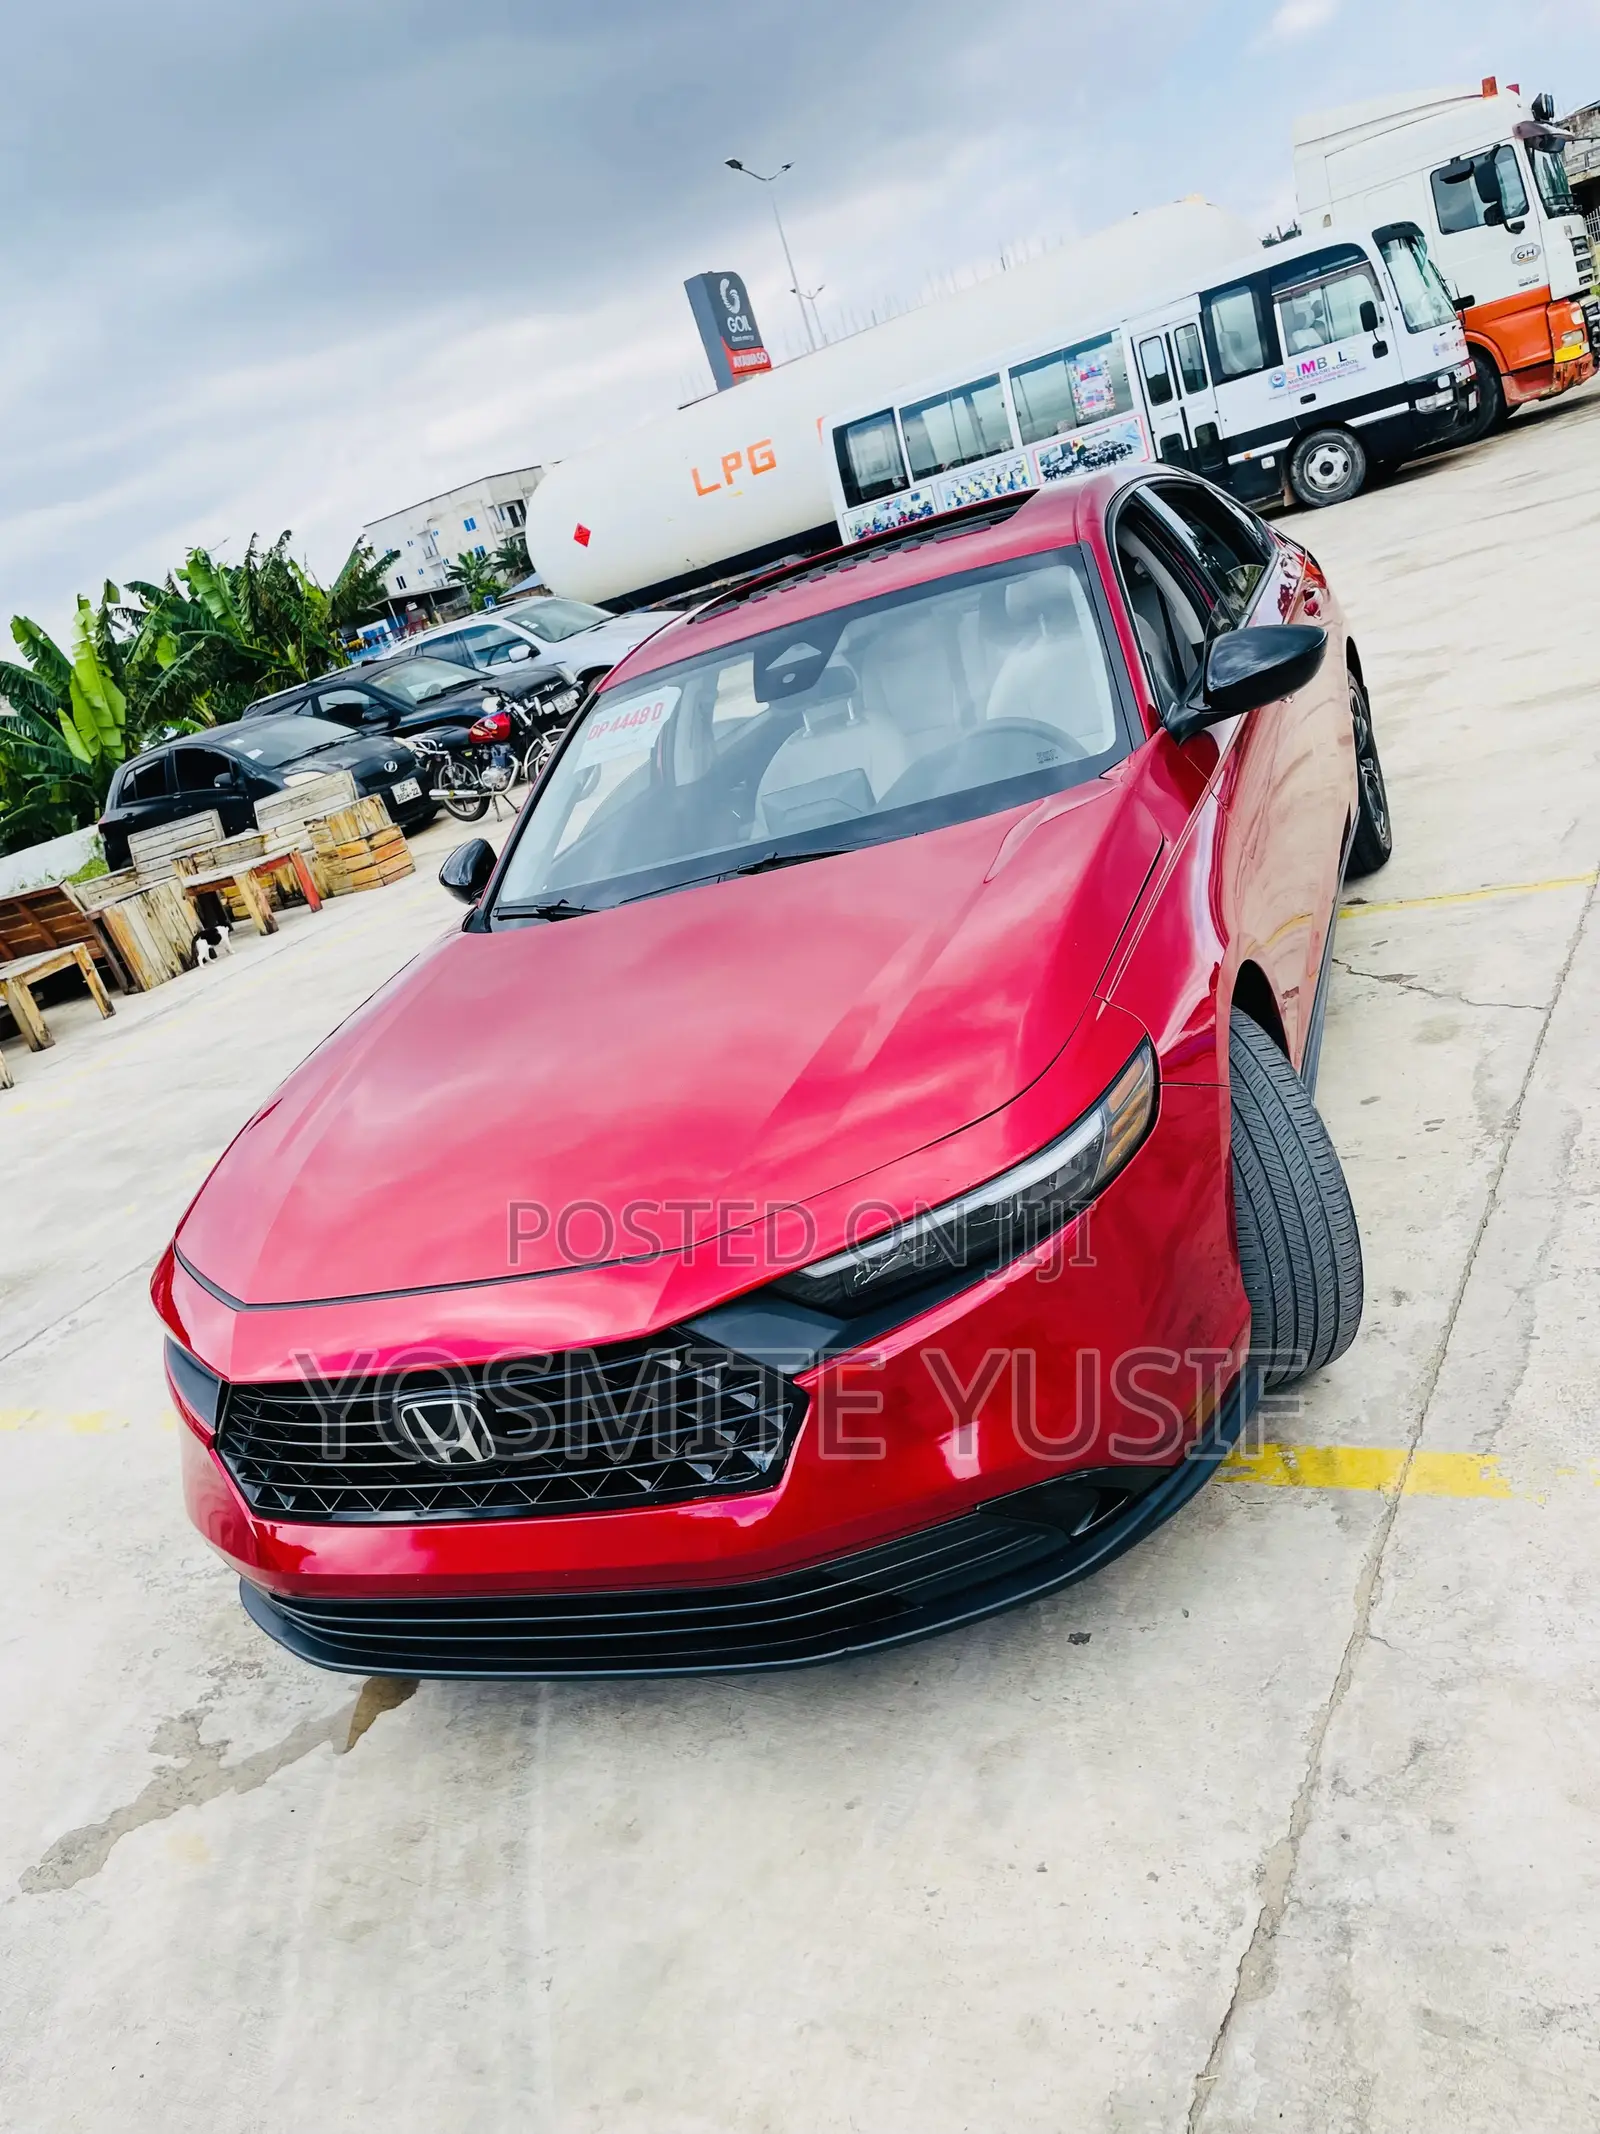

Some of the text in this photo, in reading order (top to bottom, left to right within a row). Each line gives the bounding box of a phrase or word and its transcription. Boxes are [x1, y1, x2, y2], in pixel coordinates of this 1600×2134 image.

[1517, 249, 1534, 260] GH
[727, 314, 752, 333] GOIL
[691, 438, 777, 497] LPG
[587, 721, 610, 741] DP
[609, 706, 651, 733] 4448
